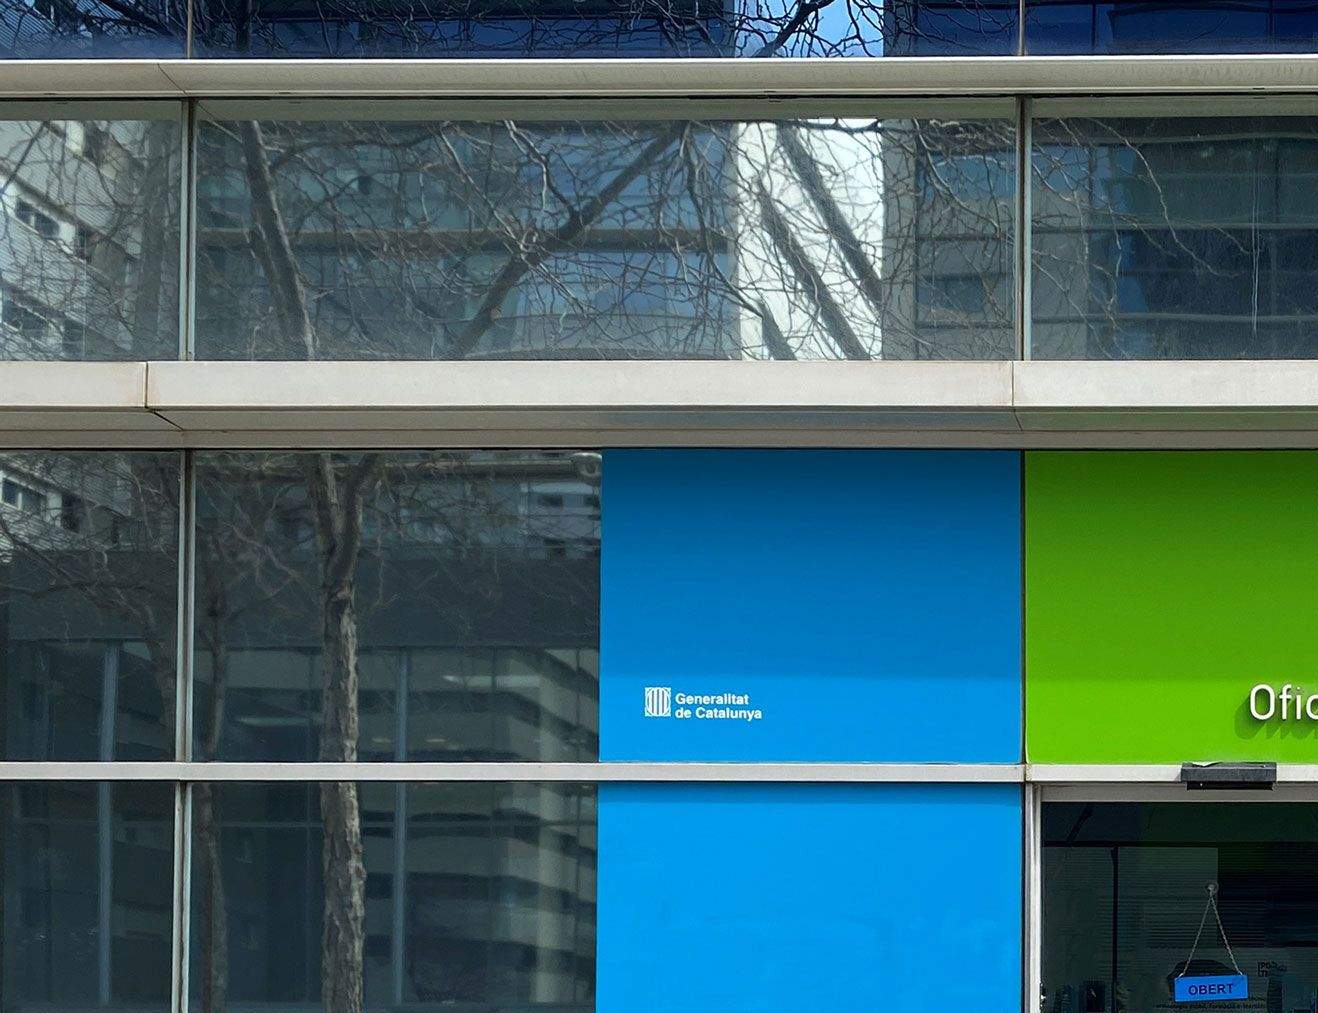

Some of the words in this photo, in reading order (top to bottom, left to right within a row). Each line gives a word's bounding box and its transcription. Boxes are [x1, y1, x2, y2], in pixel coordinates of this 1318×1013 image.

[675, 693, 750, 705] Generalitat
[675, 708, 692, 719] de
[695, 707, 762, 721] Catalunya
[1188, 983, 1234, 996] OBERT
